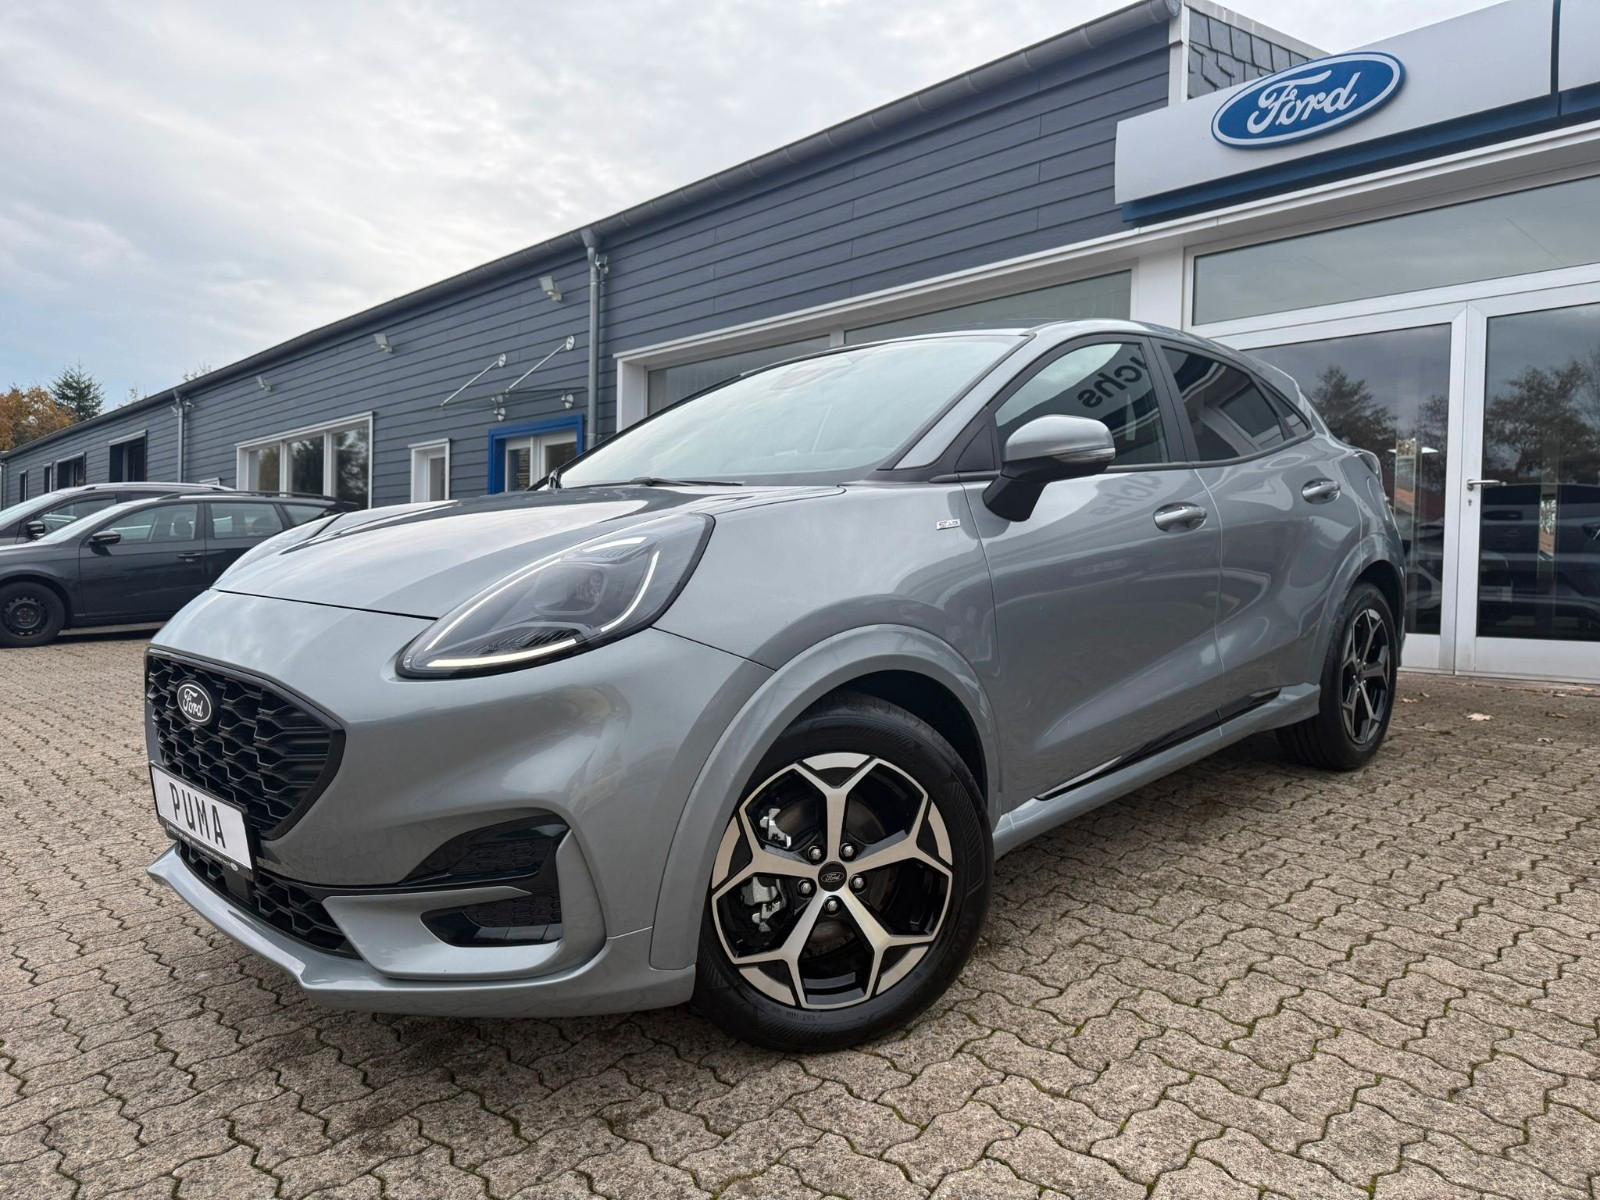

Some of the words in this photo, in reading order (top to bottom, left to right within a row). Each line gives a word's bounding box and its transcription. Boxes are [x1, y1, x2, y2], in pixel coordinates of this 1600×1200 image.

[1247, 70, 1361, 134] Ford
[183, 688, 203, 717] Ford
[169, 782, 226, 849] PUMA
